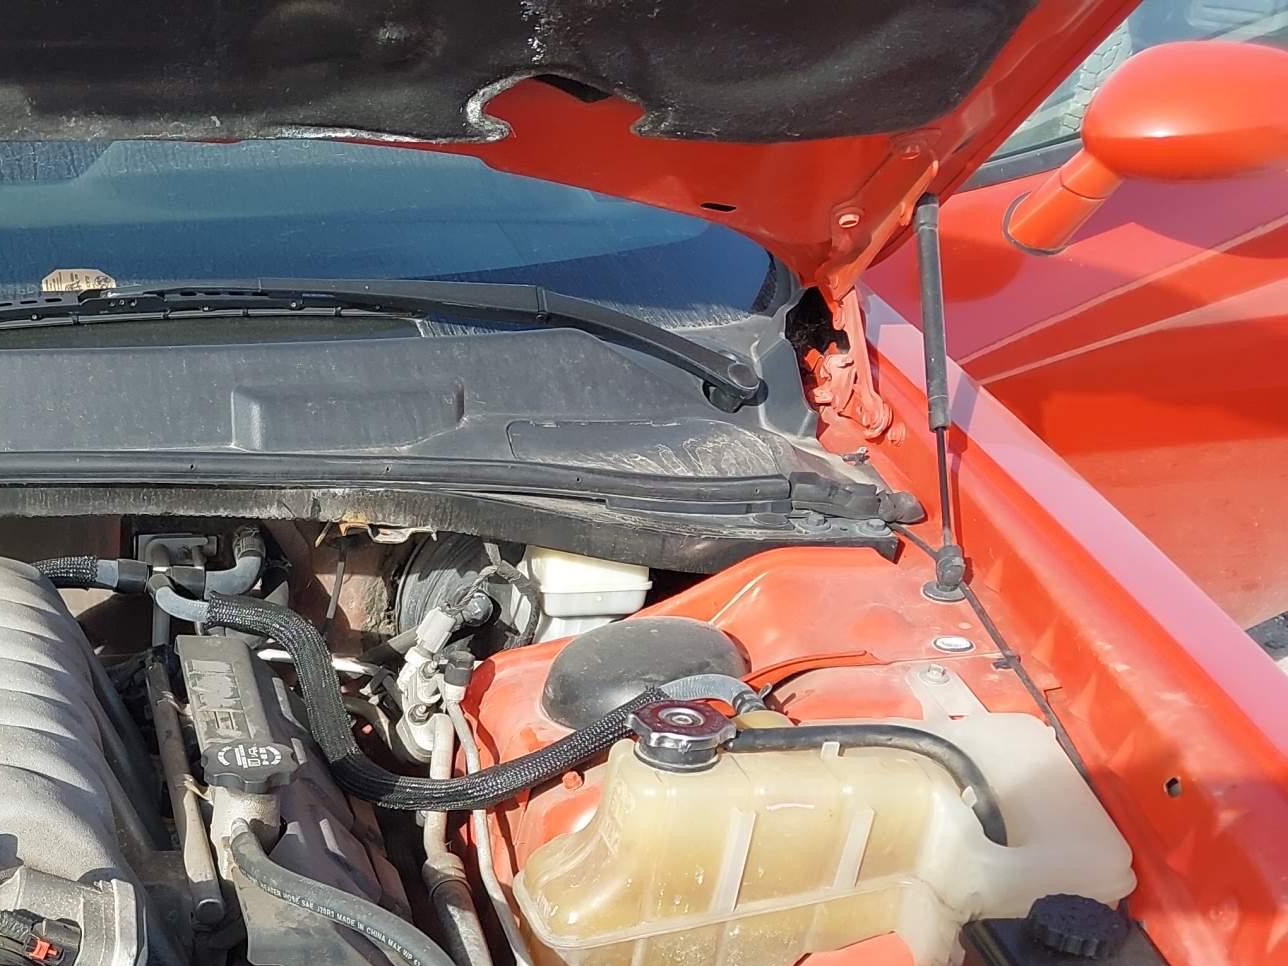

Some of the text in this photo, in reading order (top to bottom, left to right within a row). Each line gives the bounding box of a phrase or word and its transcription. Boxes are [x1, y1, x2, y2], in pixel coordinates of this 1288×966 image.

[336, 912, 356, 926] MADE
[357, 921, 365, 930] IN
[366, 927, 386, 943] CHINA
[387, 938, 402, 953] MAX
